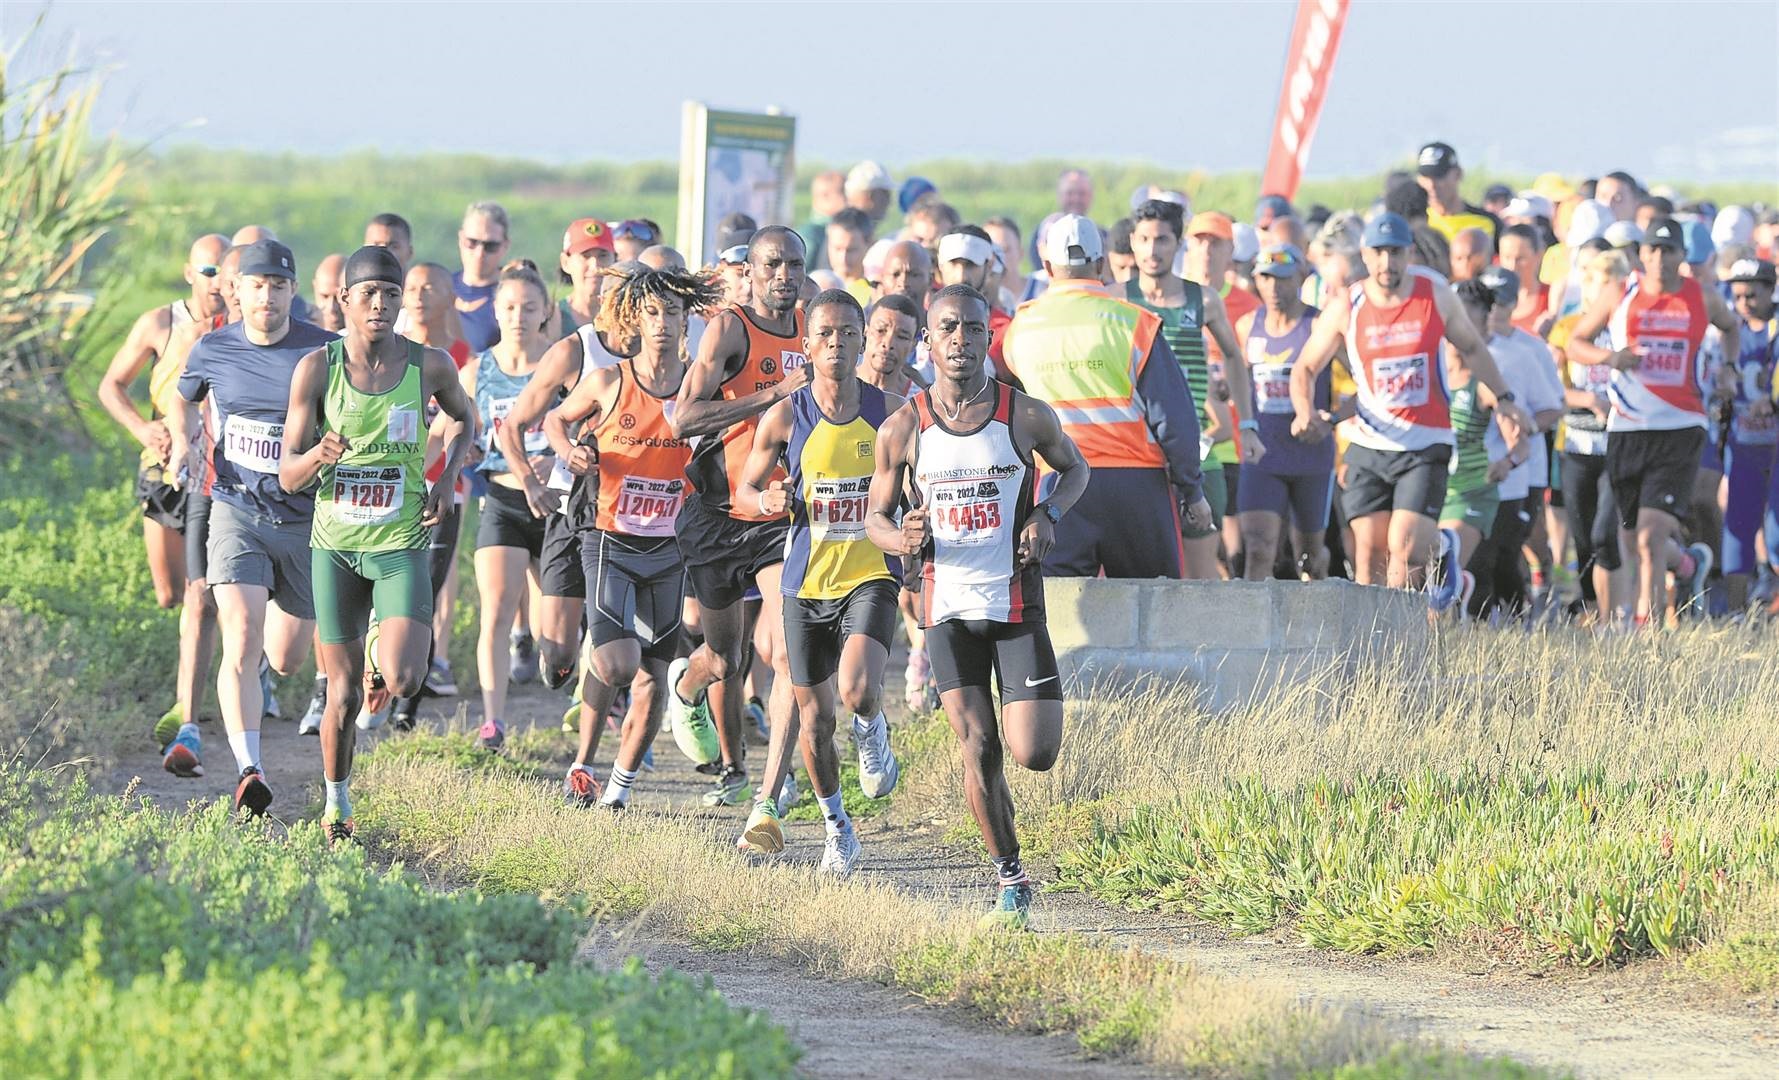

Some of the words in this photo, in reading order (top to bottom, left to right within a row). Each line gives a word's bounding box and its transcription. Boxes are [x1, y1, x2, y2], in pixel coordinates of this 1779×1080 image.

[228, 432, 234, 449] T
[239, 436, 281, 460] 47100
[361, 471, 379, 479] 2022
[928, 466, 988, 480] BRIMSTONE
[334, 481, 345, 504] P
[350, 484, 396, 508] 1287
[626, 482, 644, 490] WPA
[648, 483, 665, 491] 2022
[815, 487, 834, 495] WPA
[838, 482, 857, 493] 2022
[936, 493, 953, 502] WPA
[957, 486, 975, 499] 2022
[618, 494, 630, 515] J
[813, 499, 824, 522] P
[828, 497, 868, 524] 621
[936, 508, 945, 530] P
[949, 502, 1001, 532] 4453
